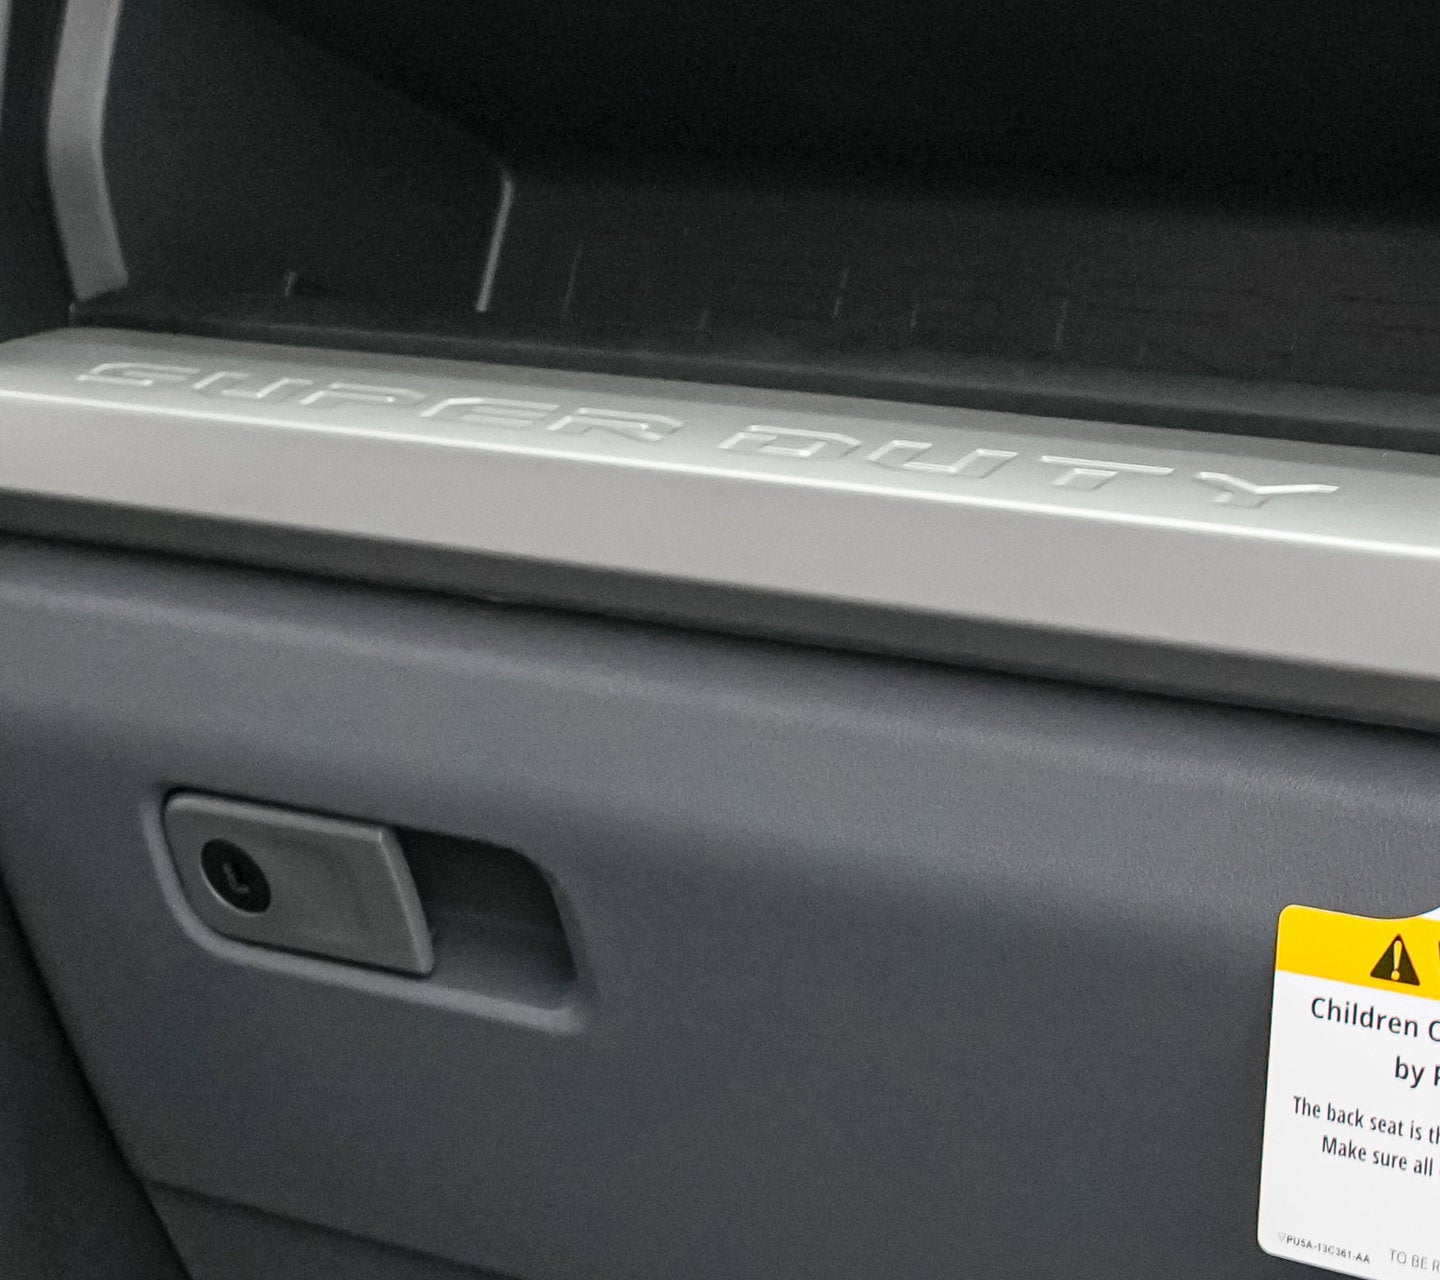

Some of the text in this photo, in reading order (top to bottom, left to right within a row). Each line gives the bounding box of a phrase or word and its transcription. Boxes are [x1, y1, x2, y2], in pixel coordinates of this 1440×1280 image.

[75, 361, 1341, 509] SUPER DUTY
[1311, 996, 1418, 1038] Children
[1395, 1055, 1426, 1089] by
[1293, 1096, 1321, 1119] The
[1327, 1102, 1364, 1128] back
[1370, 1116, 1404, 1137] seat
[1410, 1120, 1422, 1141] is
[1322, 1135, 1366, 1162] Make
[1372, 1150, 1407, 1171] sure
[1413, 1156, 1433, 1177] all
[1389, 1248, 1407, 1264] TO
[1412, 1254, 1428, 1270] BE
